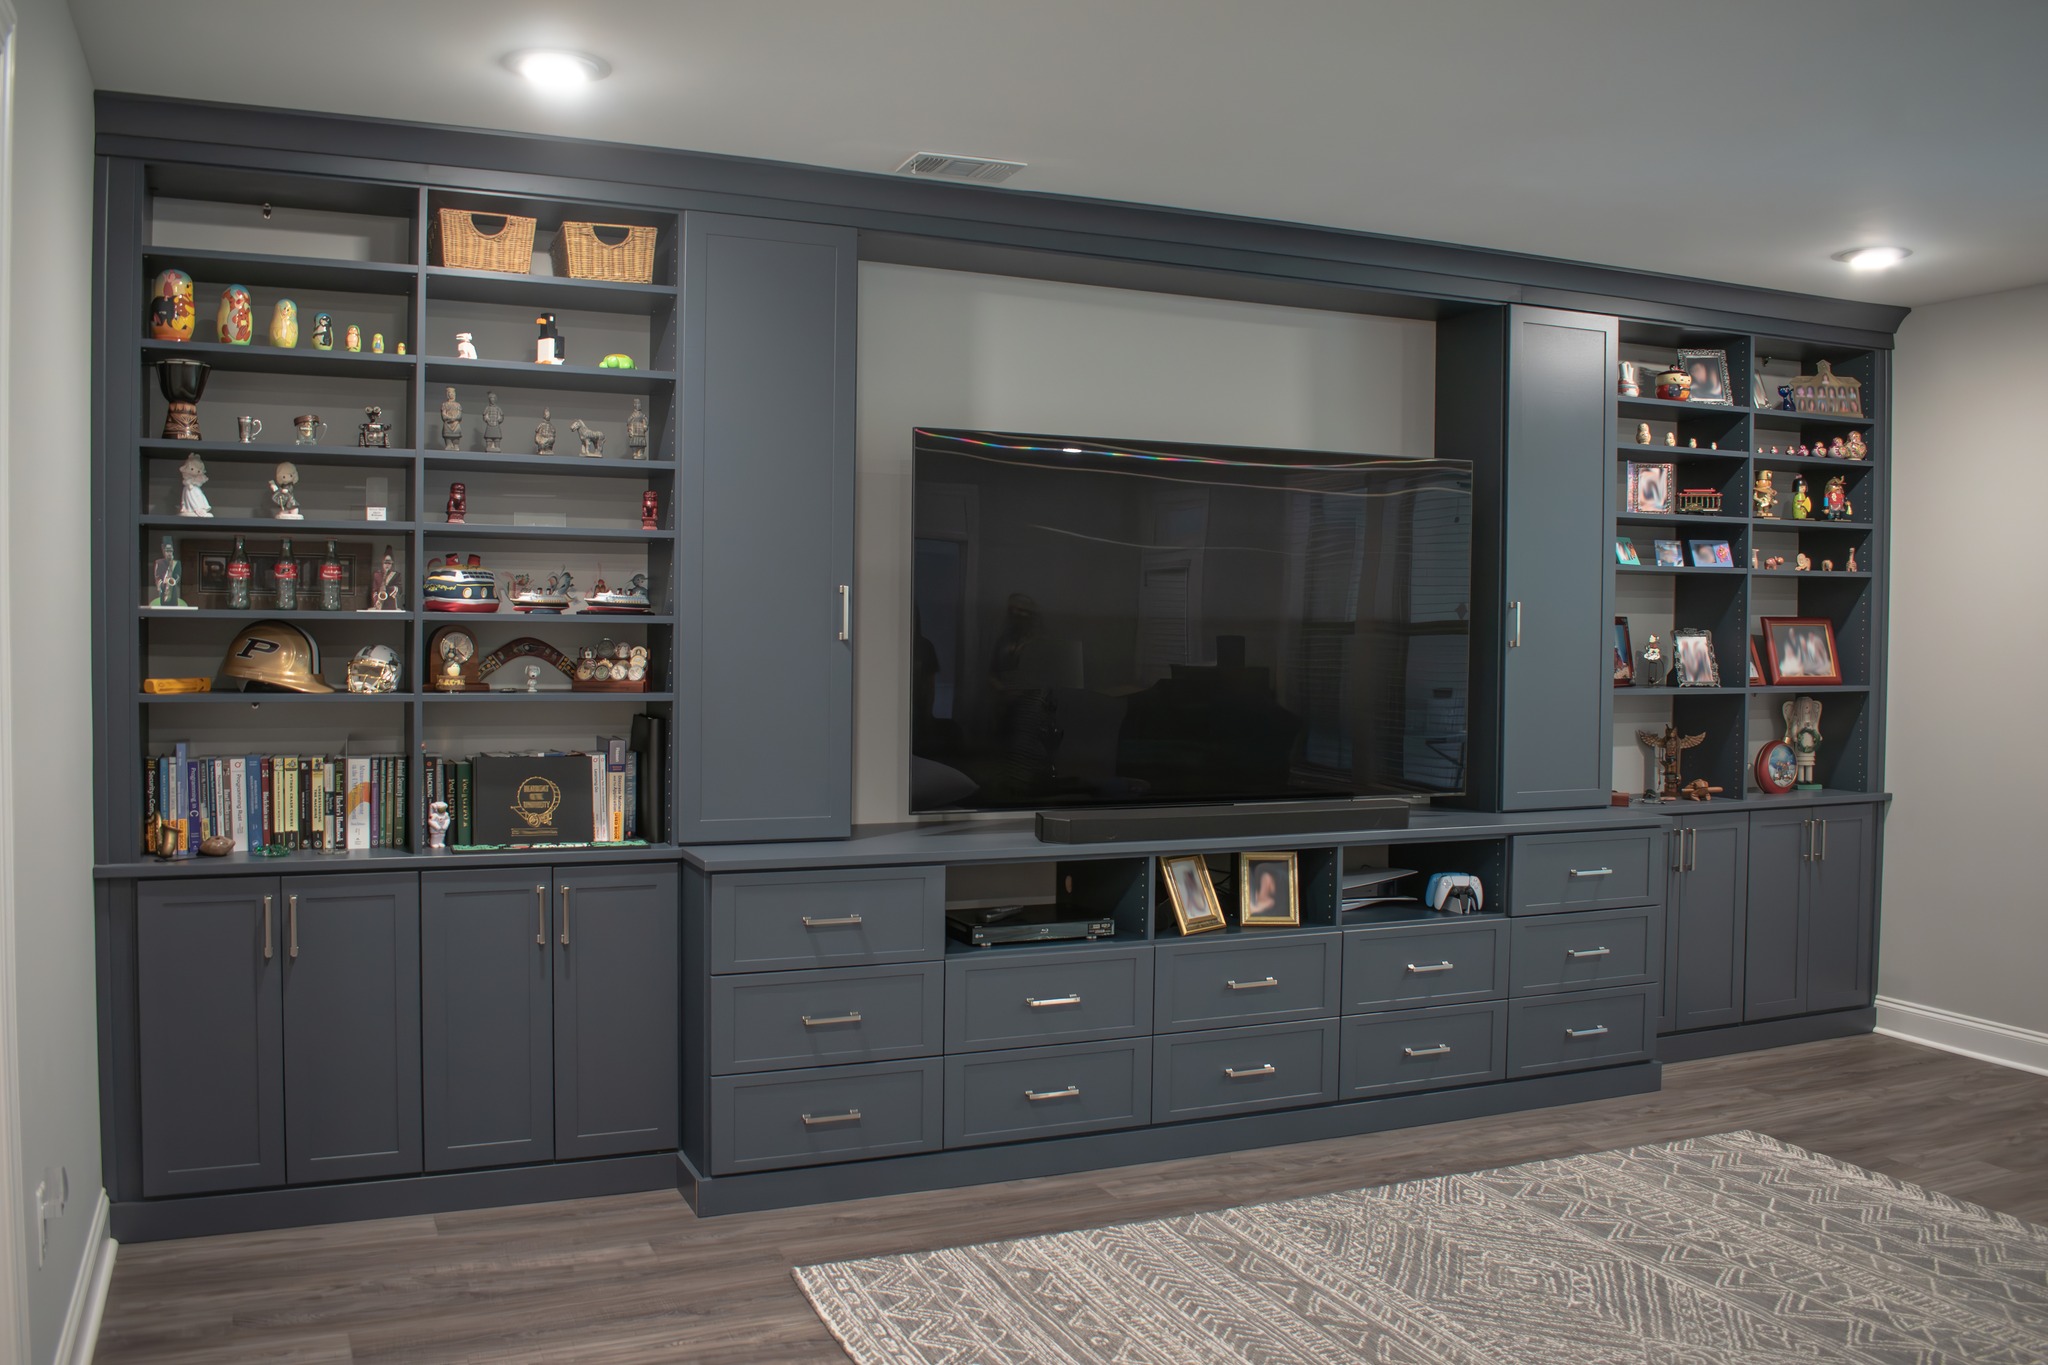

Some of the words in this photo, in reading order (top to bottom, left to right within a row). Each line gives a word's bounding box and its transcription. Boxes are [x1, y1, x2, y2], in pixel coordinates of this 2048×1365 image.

[235, 637, 281, 659] P
[397, 760, 405, 777] Android
[148, 770, 156, 795] Security
[396, 777, 405, 796] Security
[336, 795, 344, 815] Hacker's
[397, 797, 405, 817] Internals
[336, 817, 344, 842] Handbook
